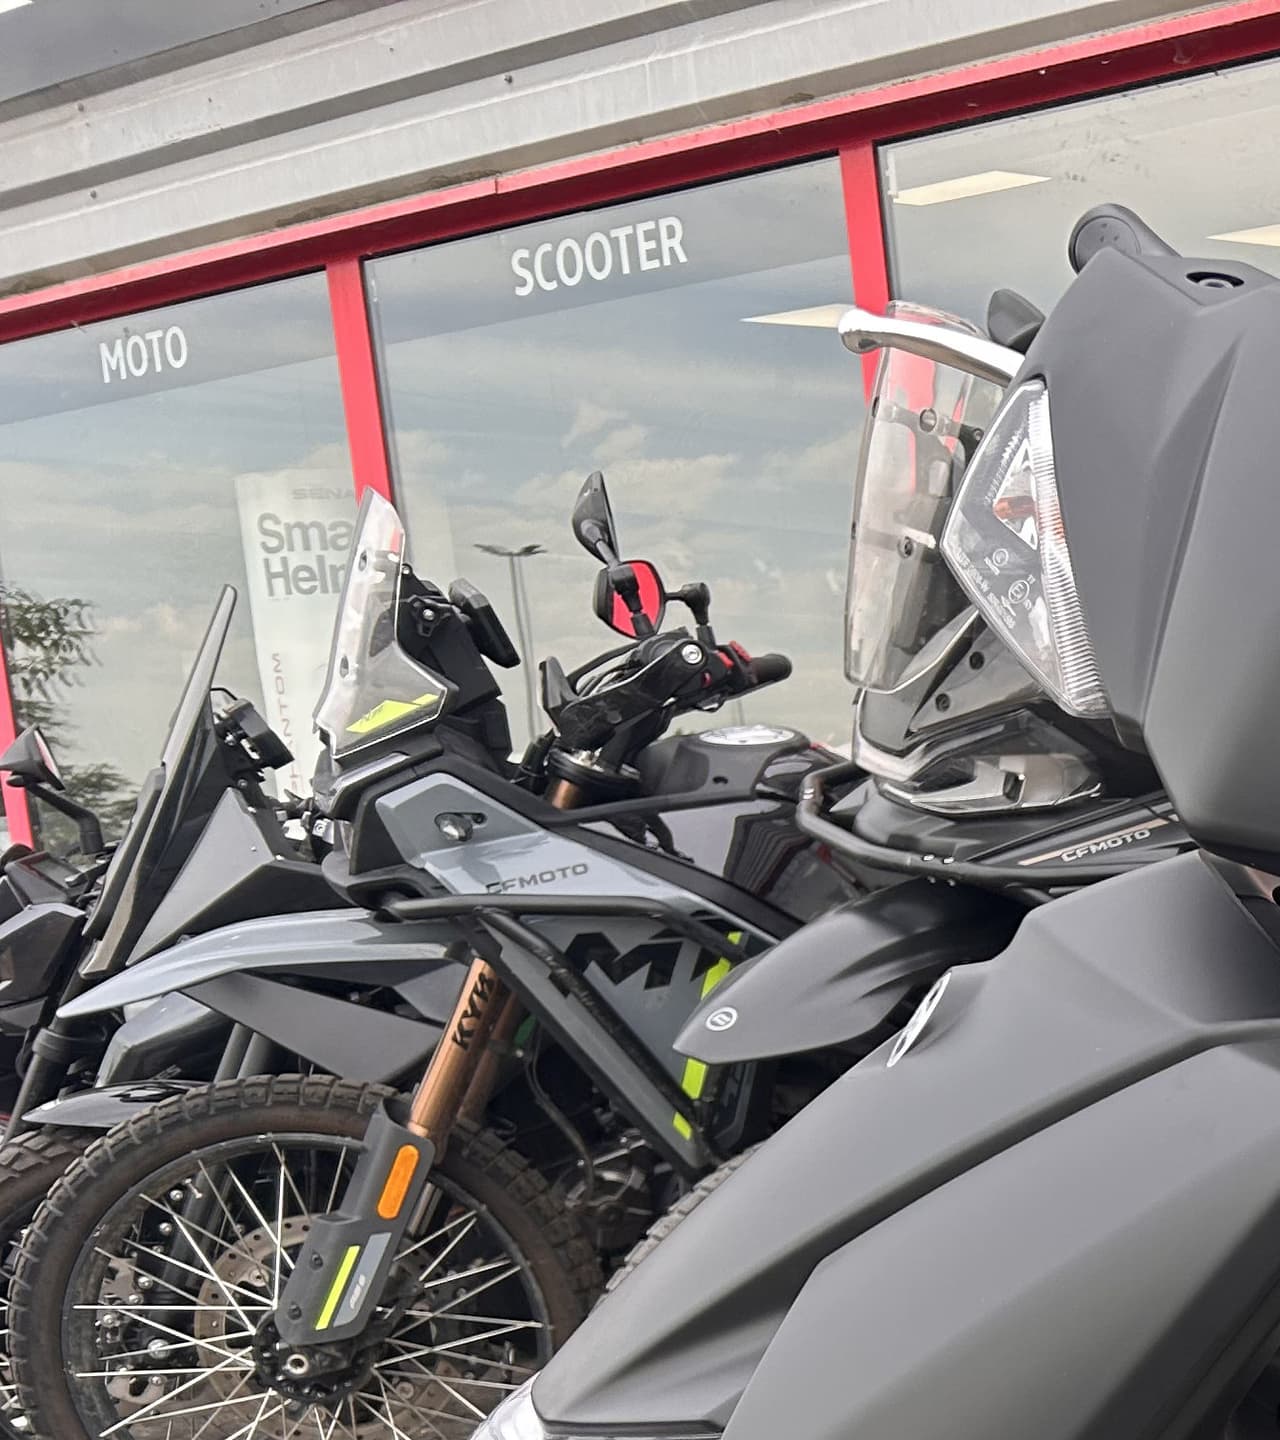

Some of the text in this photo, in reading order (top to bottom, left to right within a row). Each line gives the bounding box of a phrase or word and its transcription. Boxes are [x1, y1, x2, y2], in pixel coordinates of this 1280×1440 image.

[510, 214, 689, 297] SCOOTER
[99, 325, 188, 384] MOTO
[1060, 828, 1151, 863] CFMOTO
[485, 863, 590, 895] CFMOTO
